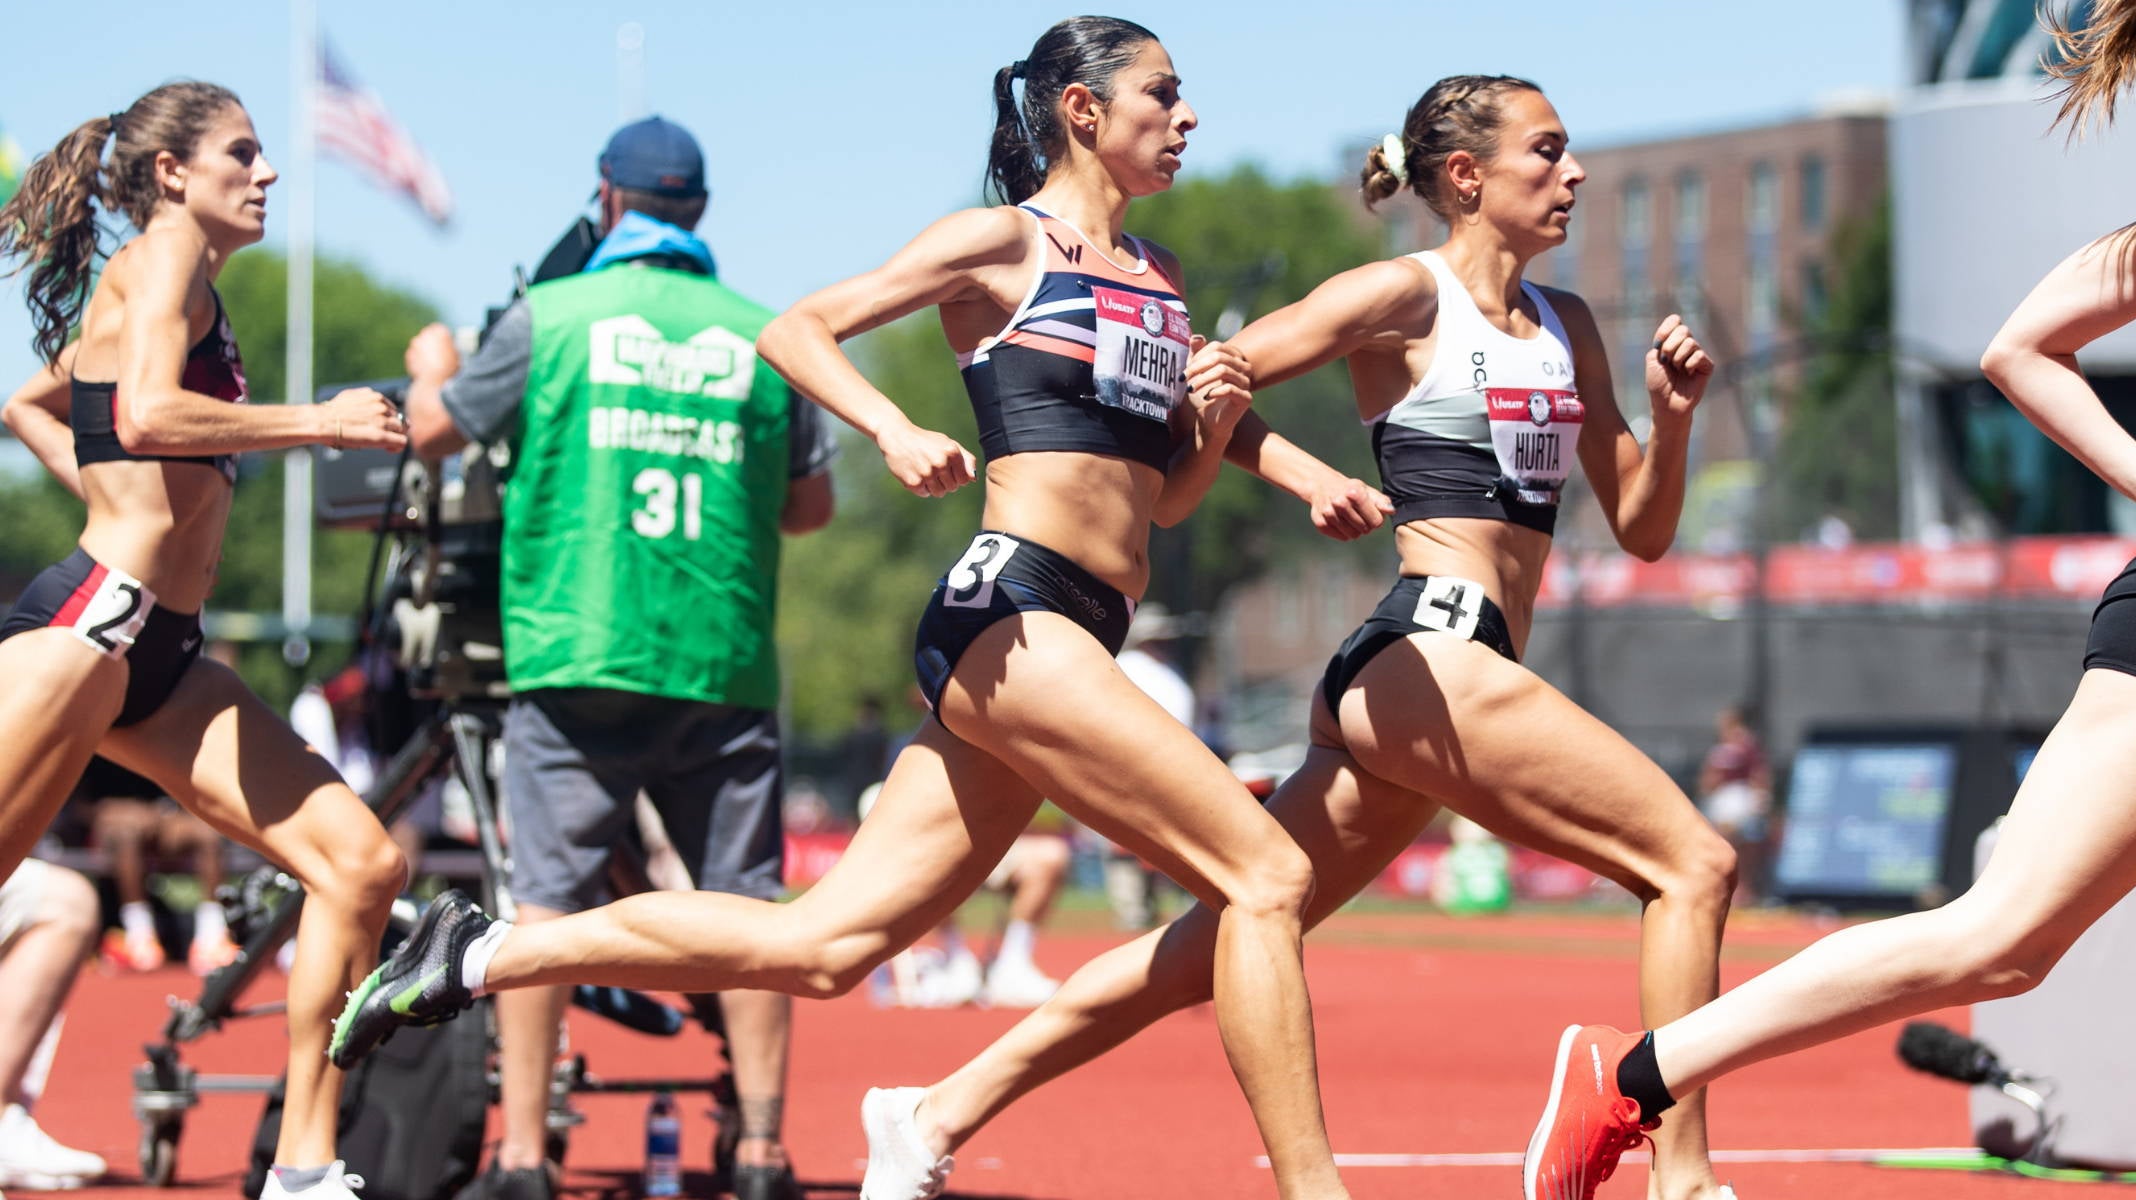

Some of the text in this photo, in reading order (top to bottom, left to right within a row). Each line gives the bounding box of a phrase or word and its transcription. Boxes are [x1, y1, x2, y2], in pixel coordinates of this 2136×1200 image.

[1123, 335, 1177, 390] MEHRA
[1121, 393, 1168, 420] TRACKTOWN
[1514, 432, 1560, 471] HURTA
[631, 467, 703, 541] 31
[952, 538, 1001, 602] 3
[86, 582, 142, 652] 2
[1429, 584, 1468, 630] 4
